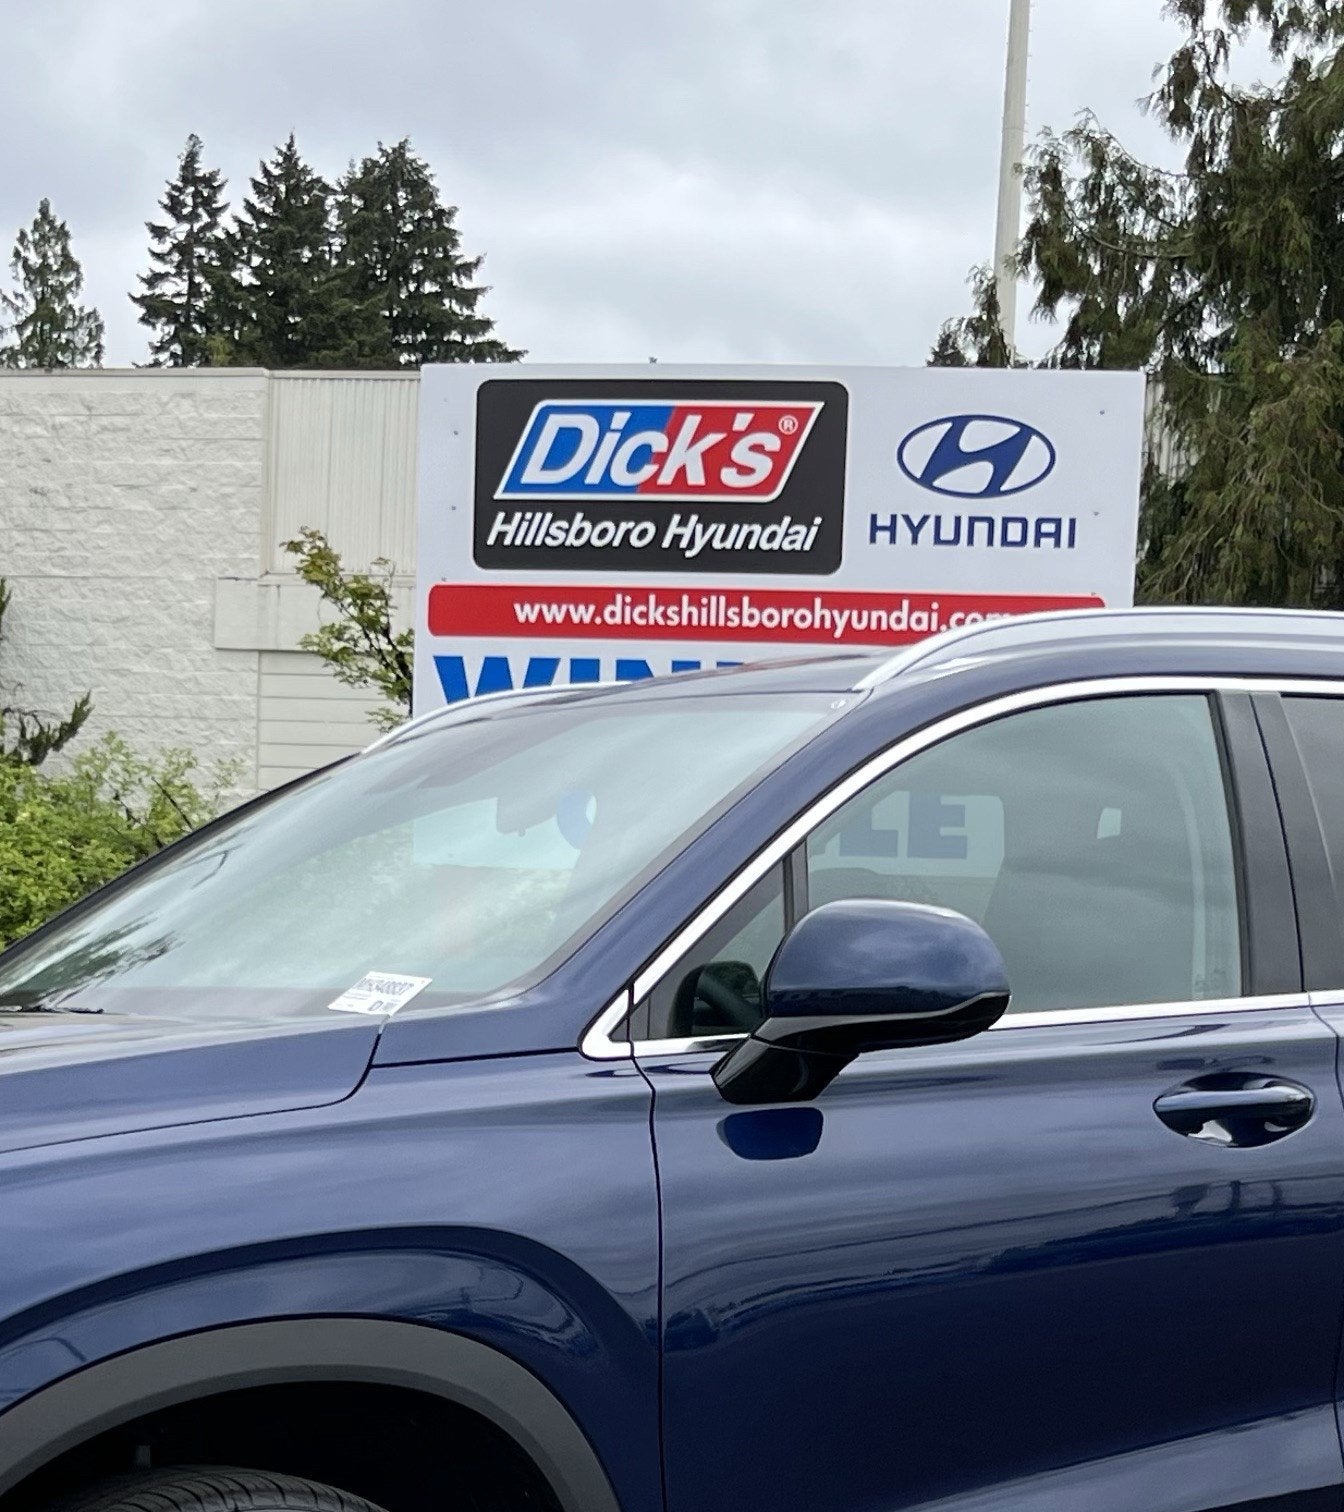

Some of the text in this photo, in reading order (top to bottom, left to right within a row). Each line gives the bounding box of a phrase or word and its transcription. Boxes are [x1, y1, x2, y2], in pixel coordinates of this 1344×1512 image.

[486, 511, 823, 559] Hillsboro Hyundai
[869, 513, 1077, 549] HYUNDAI
[513, 594, 1011, 639] www.dickshillsborohyundai.co
